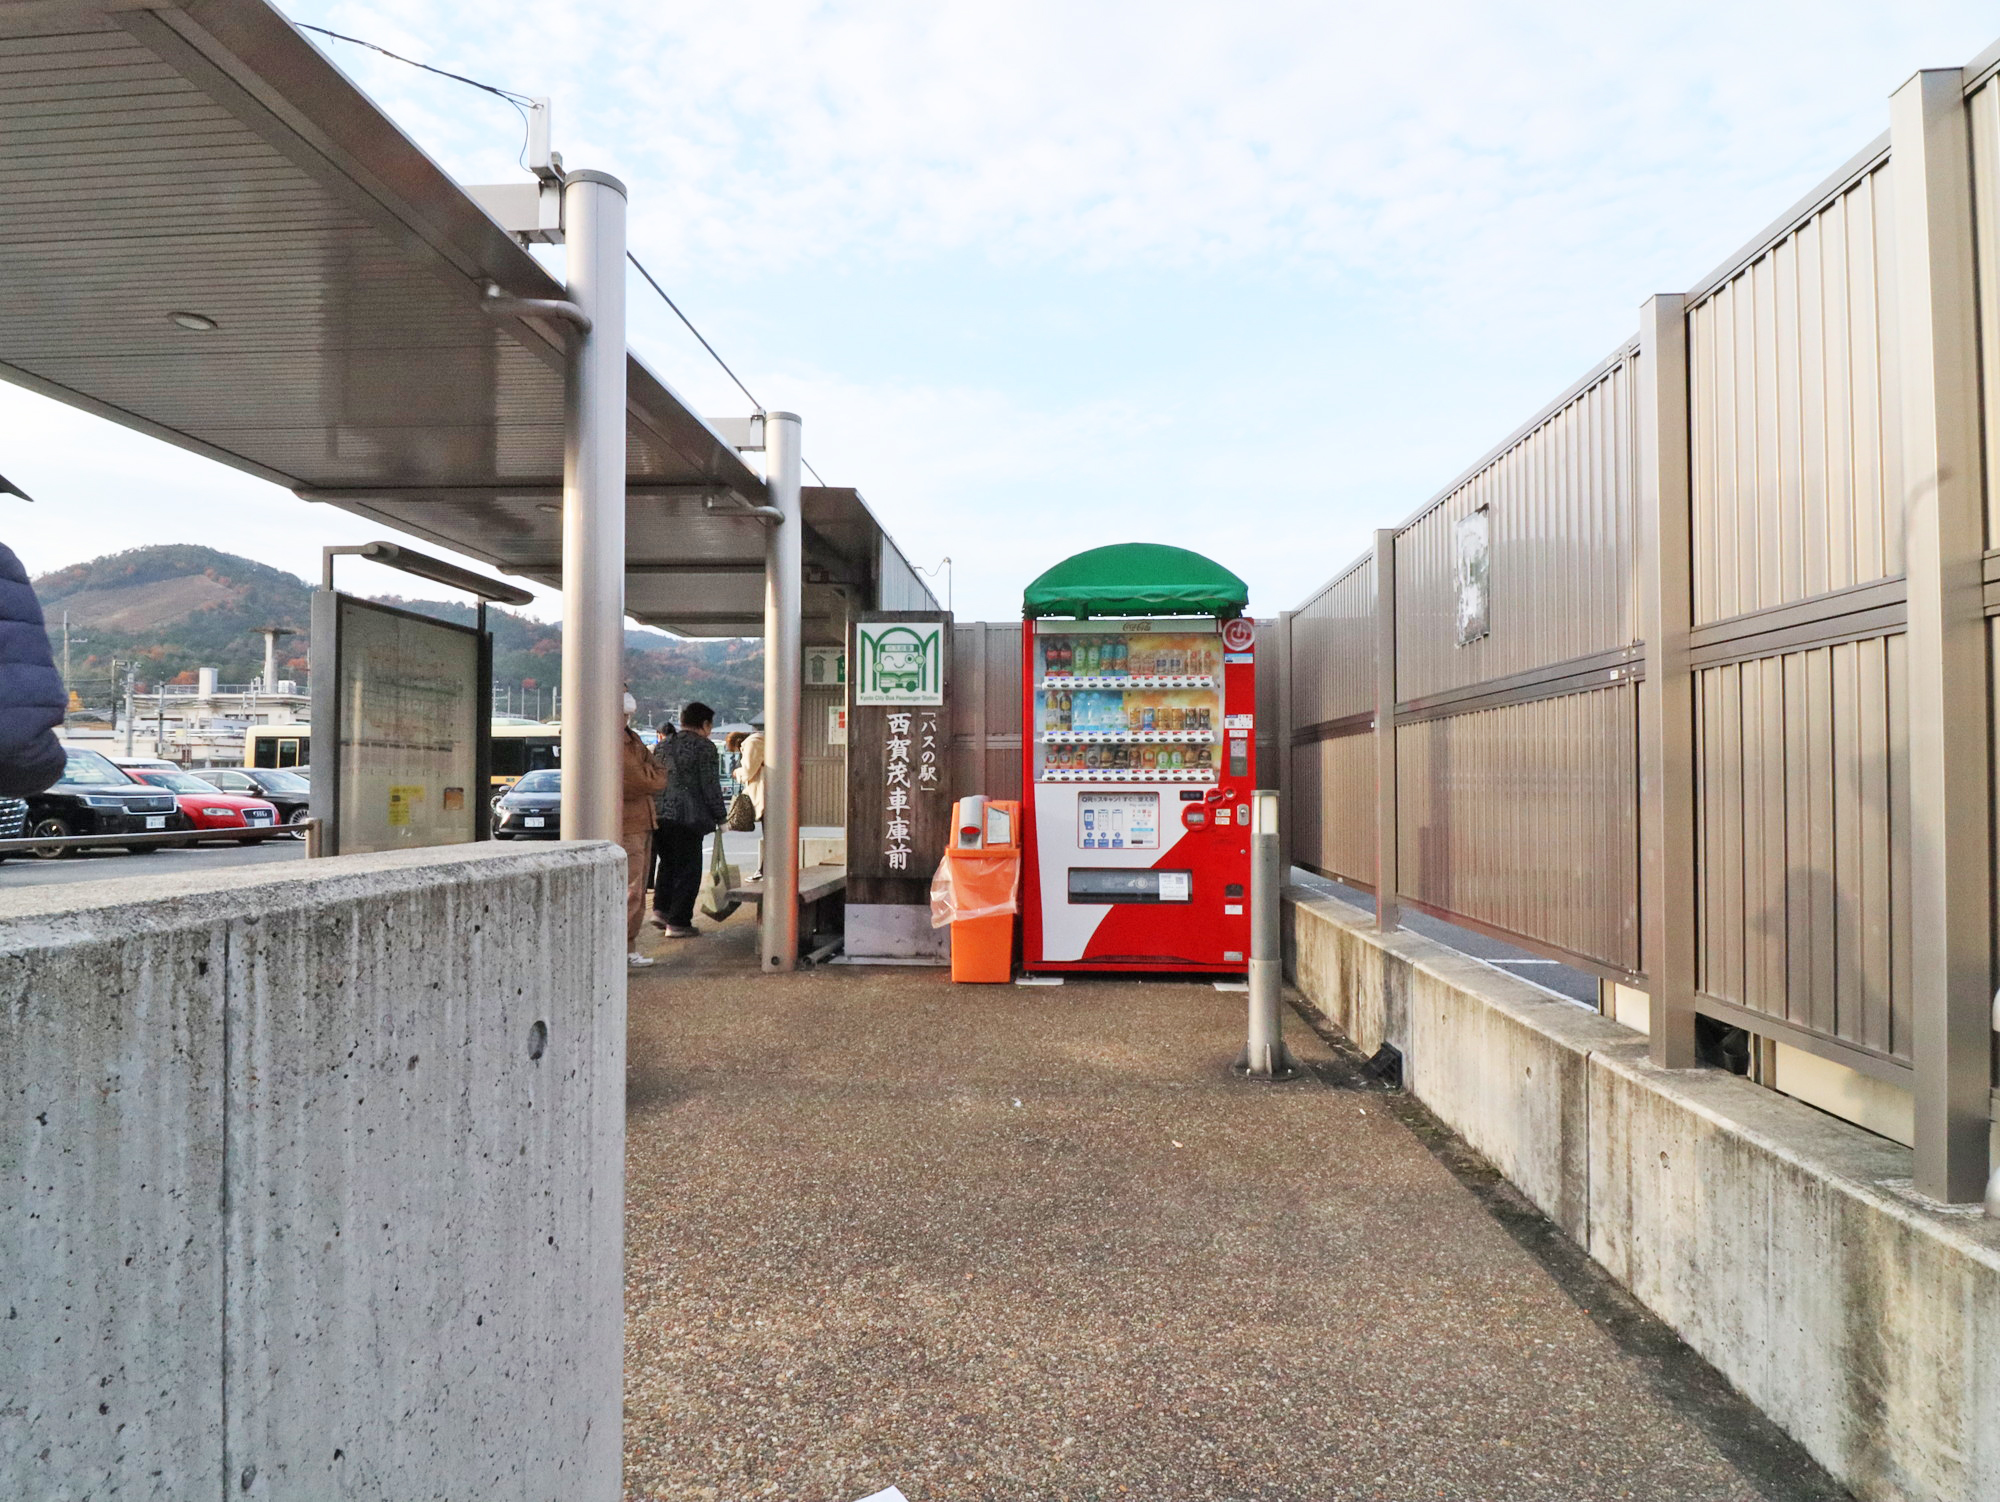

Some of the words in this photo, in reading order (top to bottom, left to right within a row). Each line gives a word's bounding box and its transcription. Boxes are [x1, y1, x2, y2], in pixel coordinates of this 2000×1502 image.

[884, 712, 912, 871] 西賀茂車庫前
[918, 712, 937, 791] 「バスの駅」
